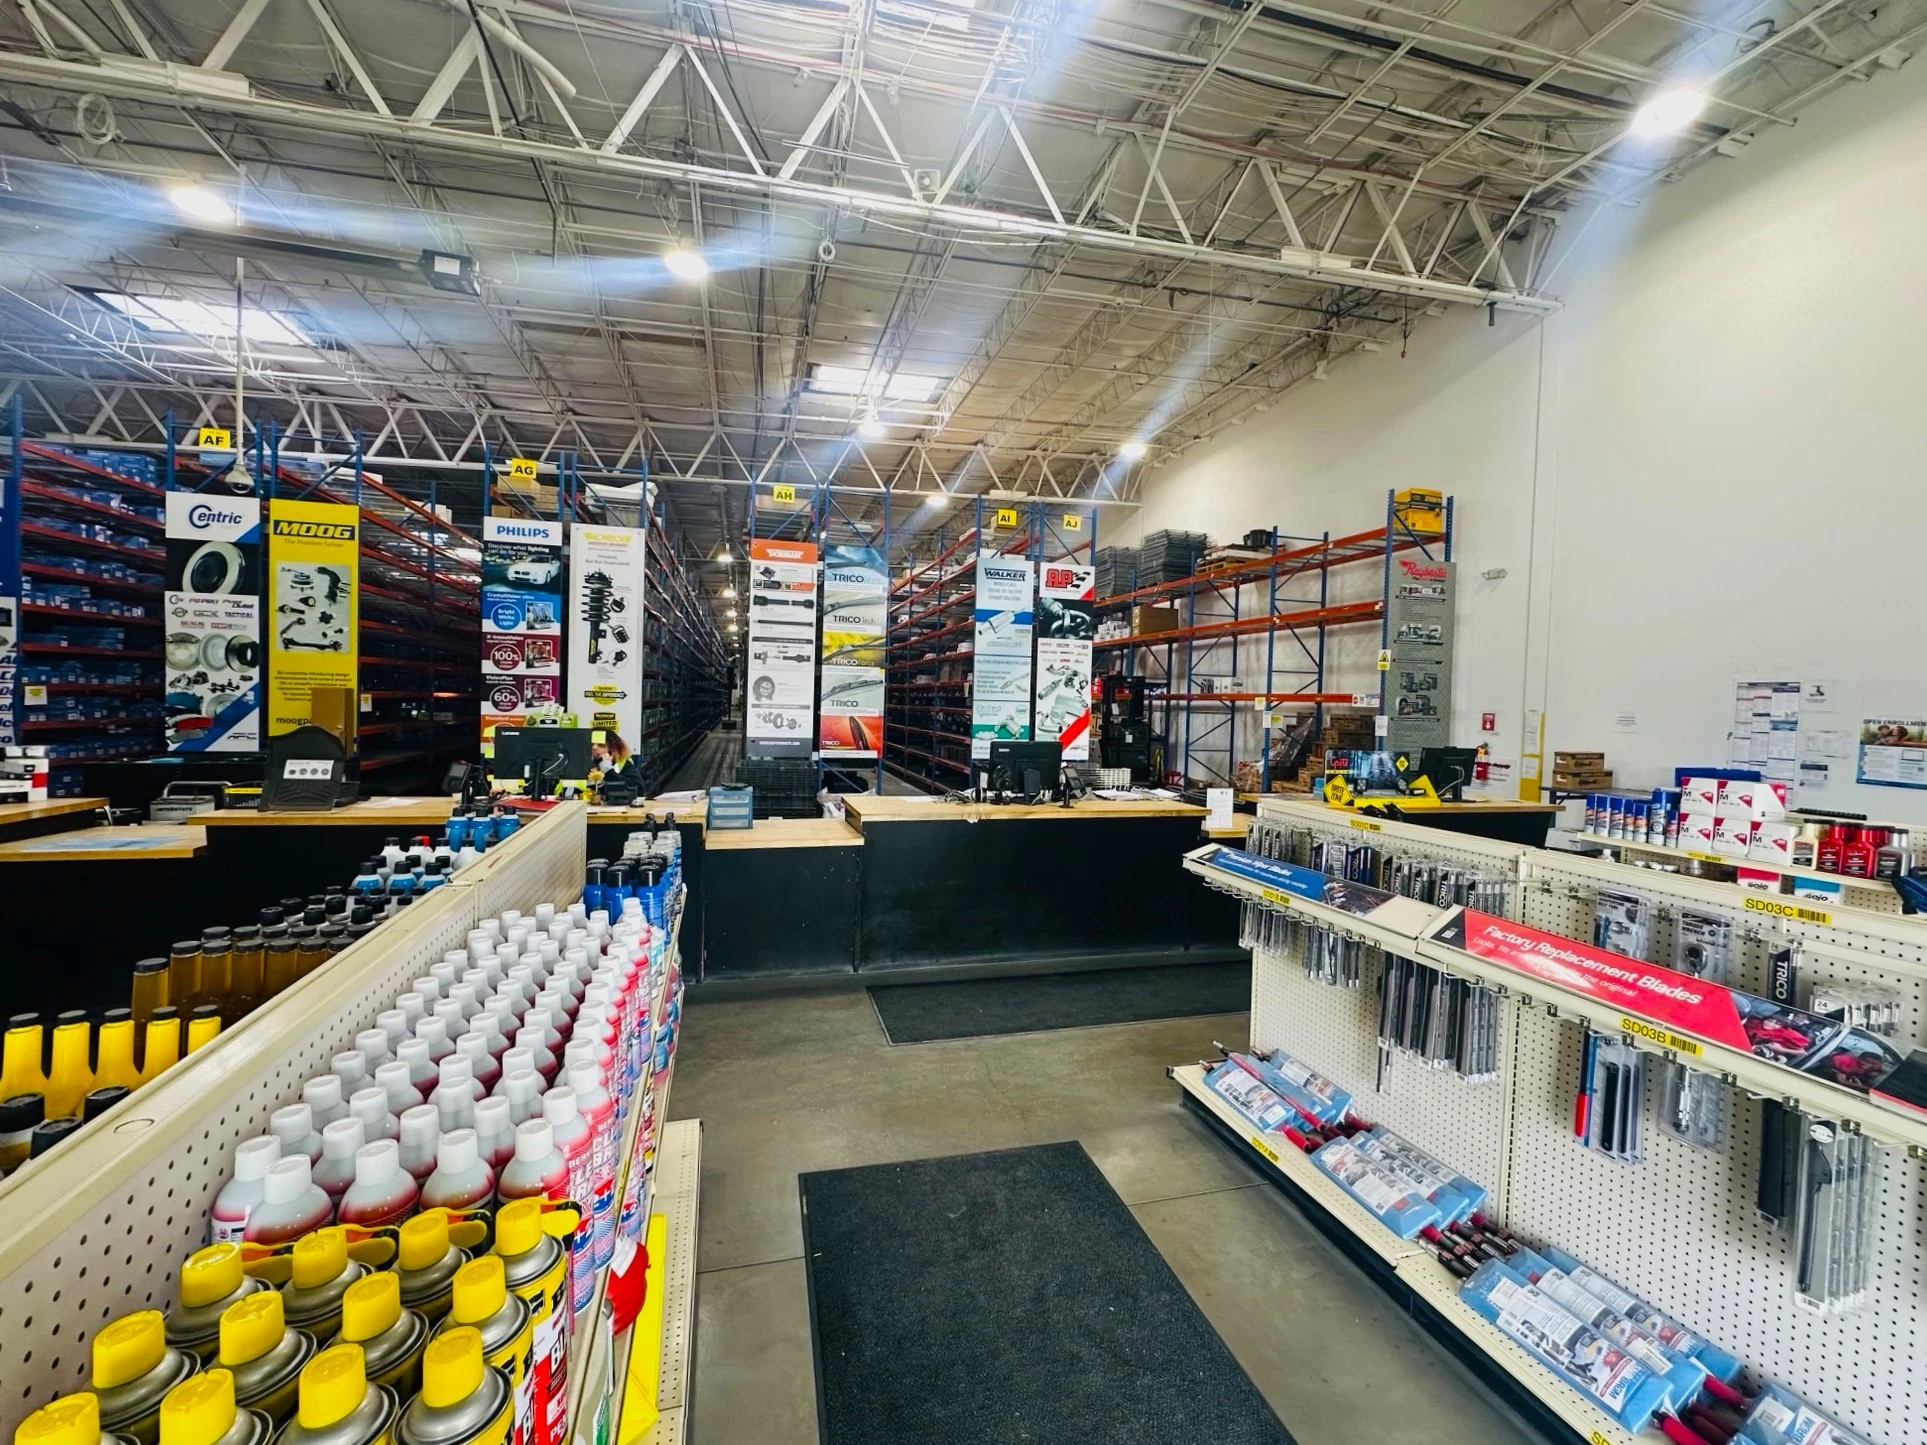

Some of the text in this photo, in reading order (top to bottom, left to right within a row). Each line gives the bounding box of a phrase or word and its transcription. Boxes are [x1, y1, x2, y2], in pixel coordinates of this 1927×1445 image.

[203, 435, 224, 445] AF
[514, 464, 534, 477] AG
[776, 490, 793, 501] AH
[189, 504, 243, 529] Centric
[1000, 514, 1010, 523] AI
[1065, 519, 1078, 528] AJ
[276, 521, 353, 539] MOOG
[496, 525, 550, 539] PHILIPS
[831, 572, 865, 583] TRICO
[984, 567, 1027, 581] WALKER
[1045, 568, 1074, 589] AP
[831, 614, 861, 624] TRICO
[494, 650, 519, 661] 100%
[493, 692, 517, 703] 60%
[830, 699, 859, 708] TRICO
[1351, 853, 1360, 880] TRICO
[1438, 880, 1448, 907] TRICO
[1745, 898, 1794, 917] SD03C
[1483, 925, 1536, 950] Factory
[1535, 941, 1638, 983] Replacement
[1636, 975, 1703, 1005] Blades
[1775, 960, 1788, 999] TRICO
[1599, 981, 1638, 998] original
[1622, 1018, 1667, 1044] SD03B
